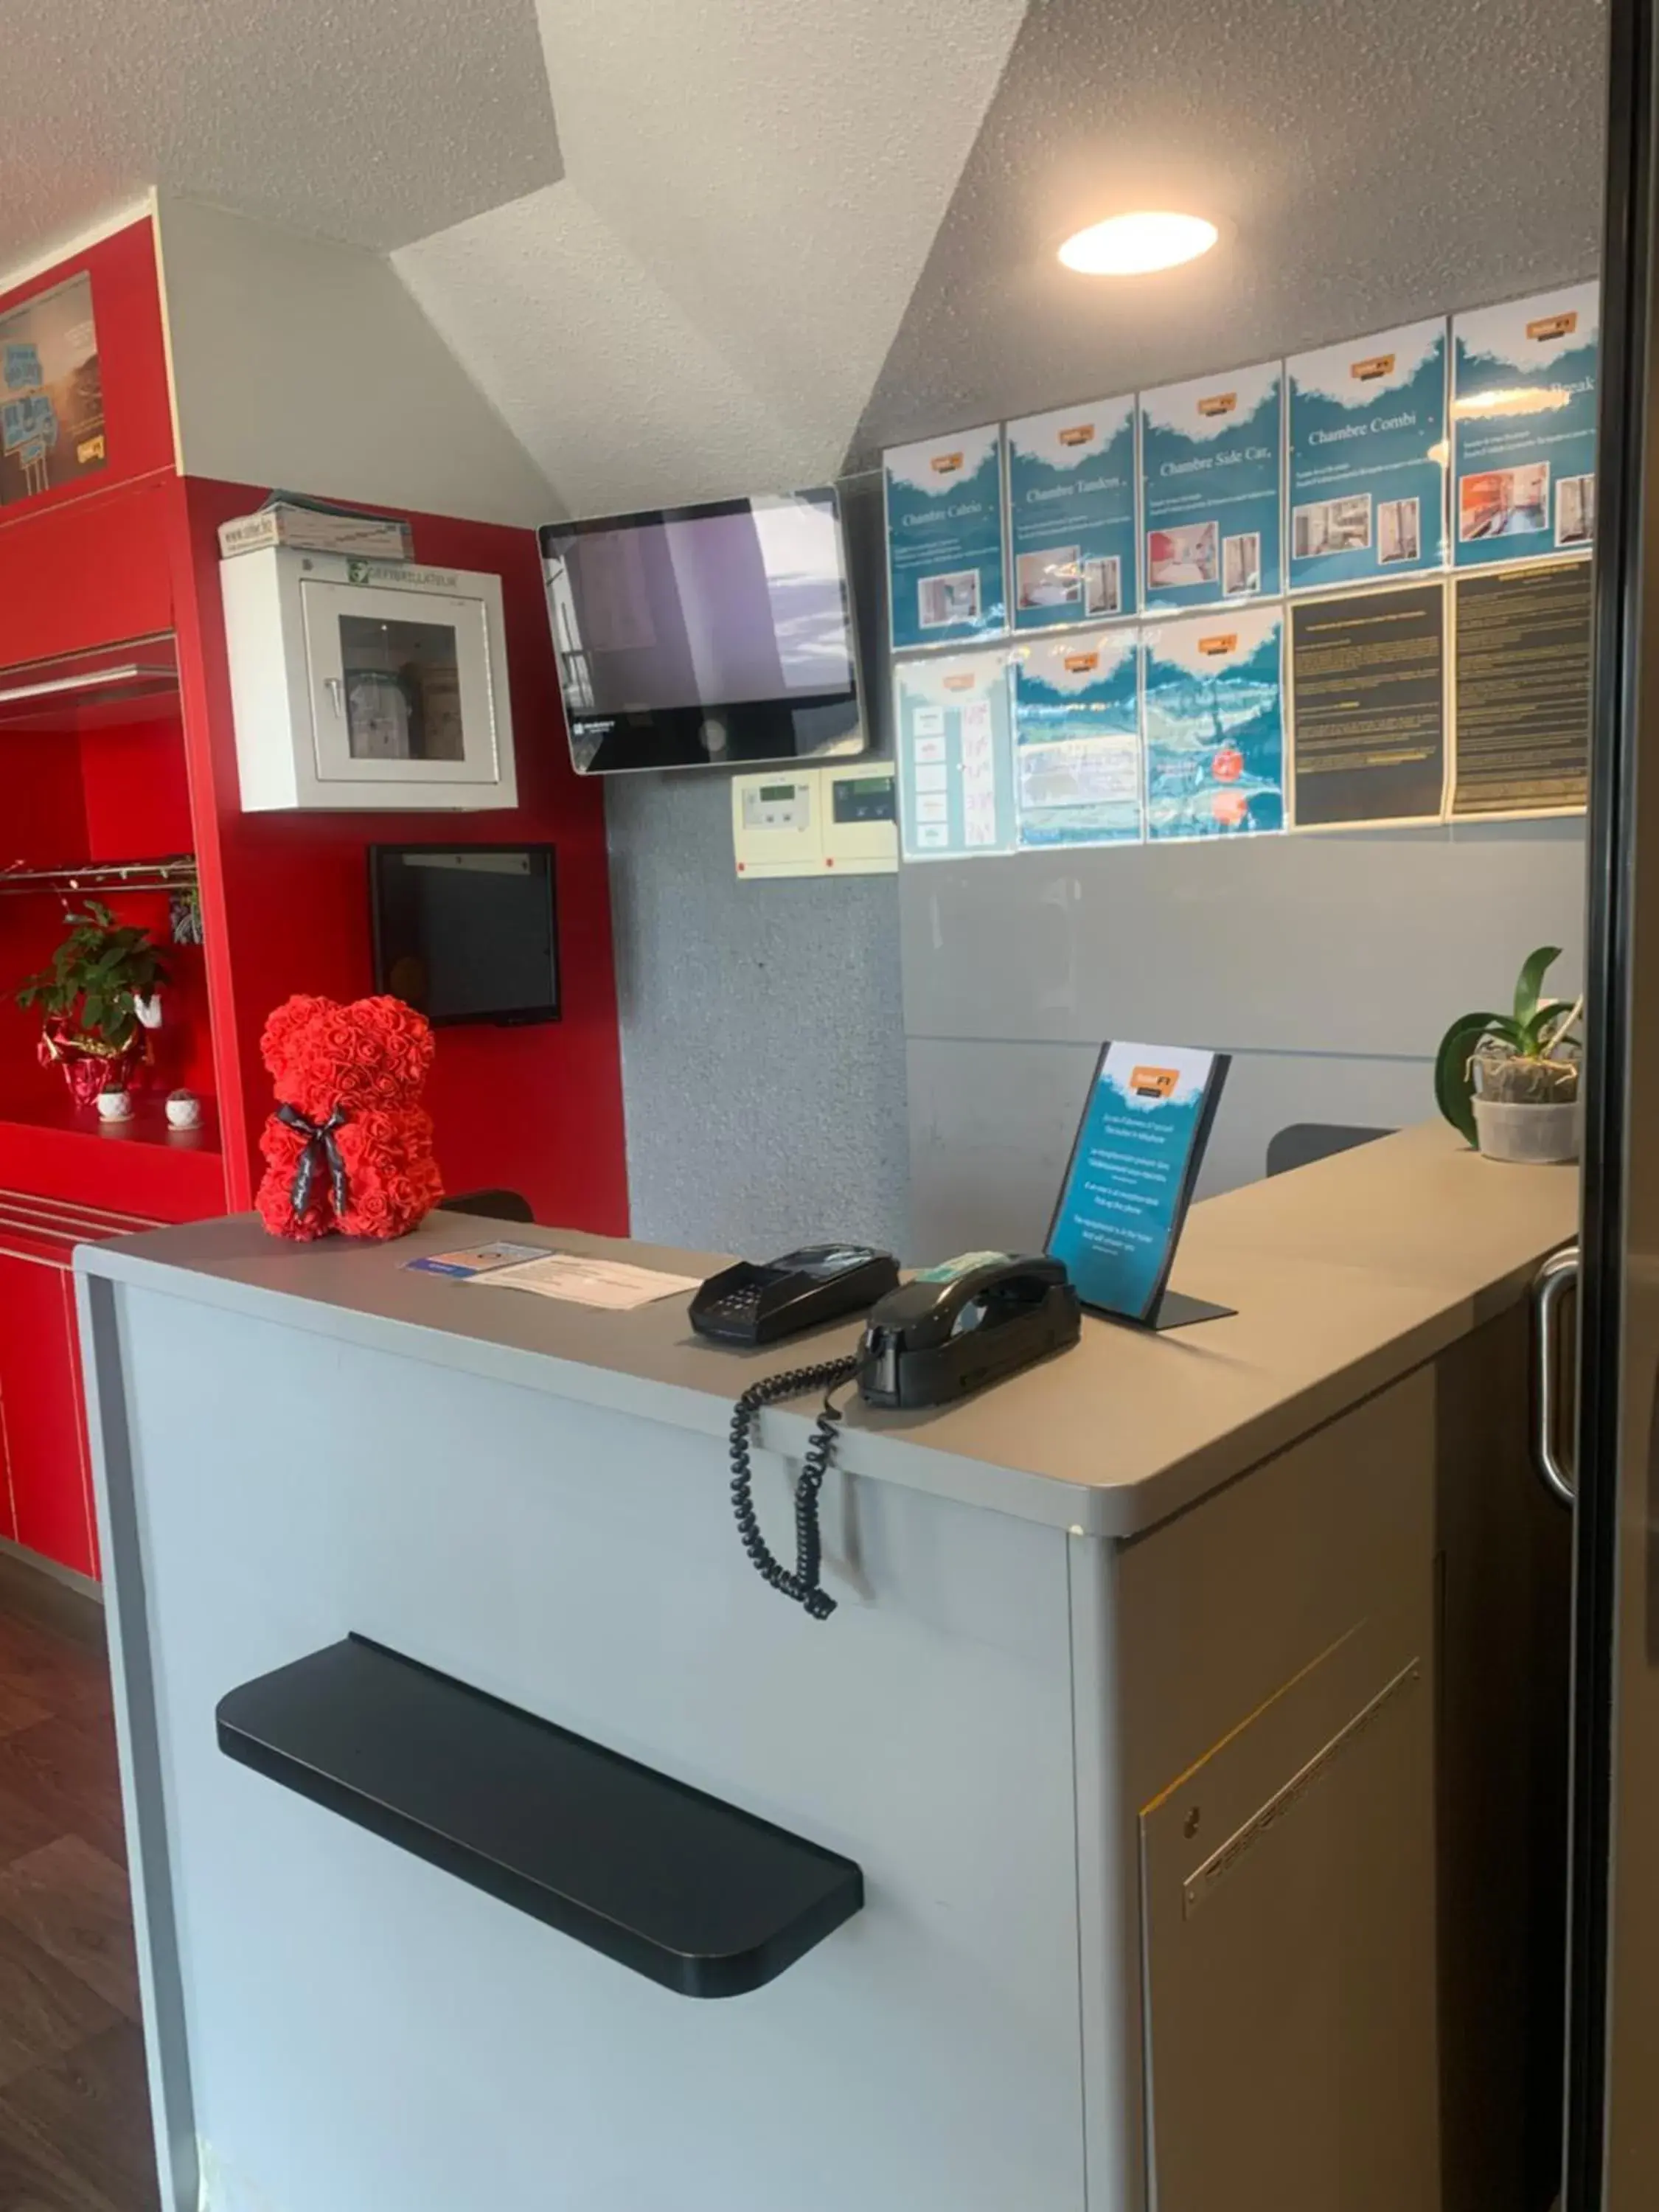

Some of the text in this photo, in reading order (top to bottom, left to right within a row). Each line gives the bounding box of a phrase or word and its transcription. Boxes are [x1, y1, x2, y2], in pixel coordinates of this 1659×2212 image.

[1307, 409, 1418, 447] Chambre Combi
[1159, 456, 1214, 478] Chambre
[1214, 450, 1243, 467] Side
[1026, 475, 1120, 504] Chambre Tandem
[901, 509, 947, 527] Chambre
